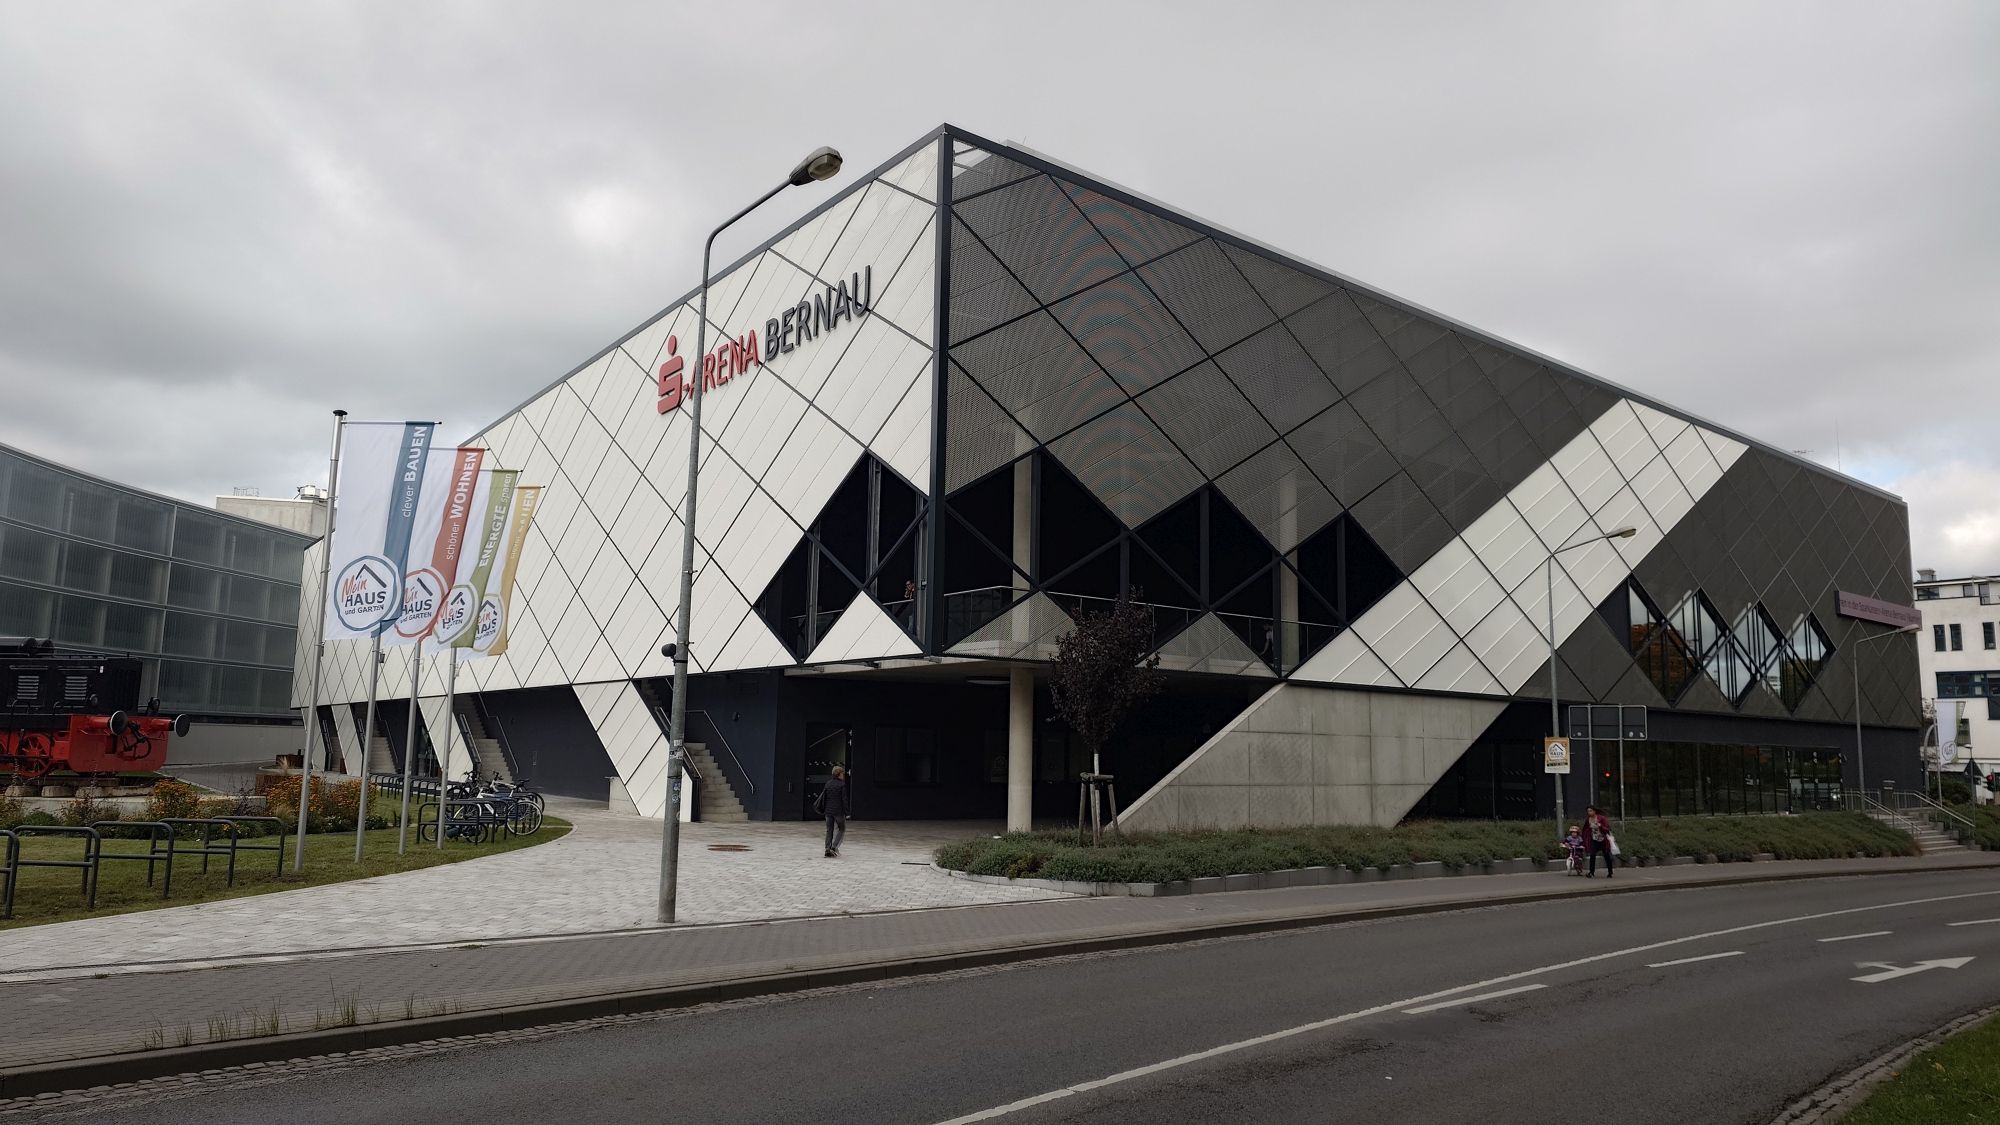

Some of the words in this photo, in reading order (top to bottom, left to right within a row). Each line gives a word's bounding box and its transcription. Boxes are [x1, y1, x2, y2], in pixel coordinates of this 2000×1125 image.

[765, 265, 871, 363] BERNAU
[404, 426, 428, 482] BAUEN
[402, 485, 414, 518] clever
[449, 452, 479, 519] WOHNEN
[479, 505, 506, 567] ENERGIE
[501, 473, 513, 503] sparen
[446, 522, 460, 560] schöner
[341, 575, 368, 603] Mein
[345, 591, 387, 607] HAUS
[357, 604, 385, 614] GARTEN
[408, 612, 432, 621] GARTEN
